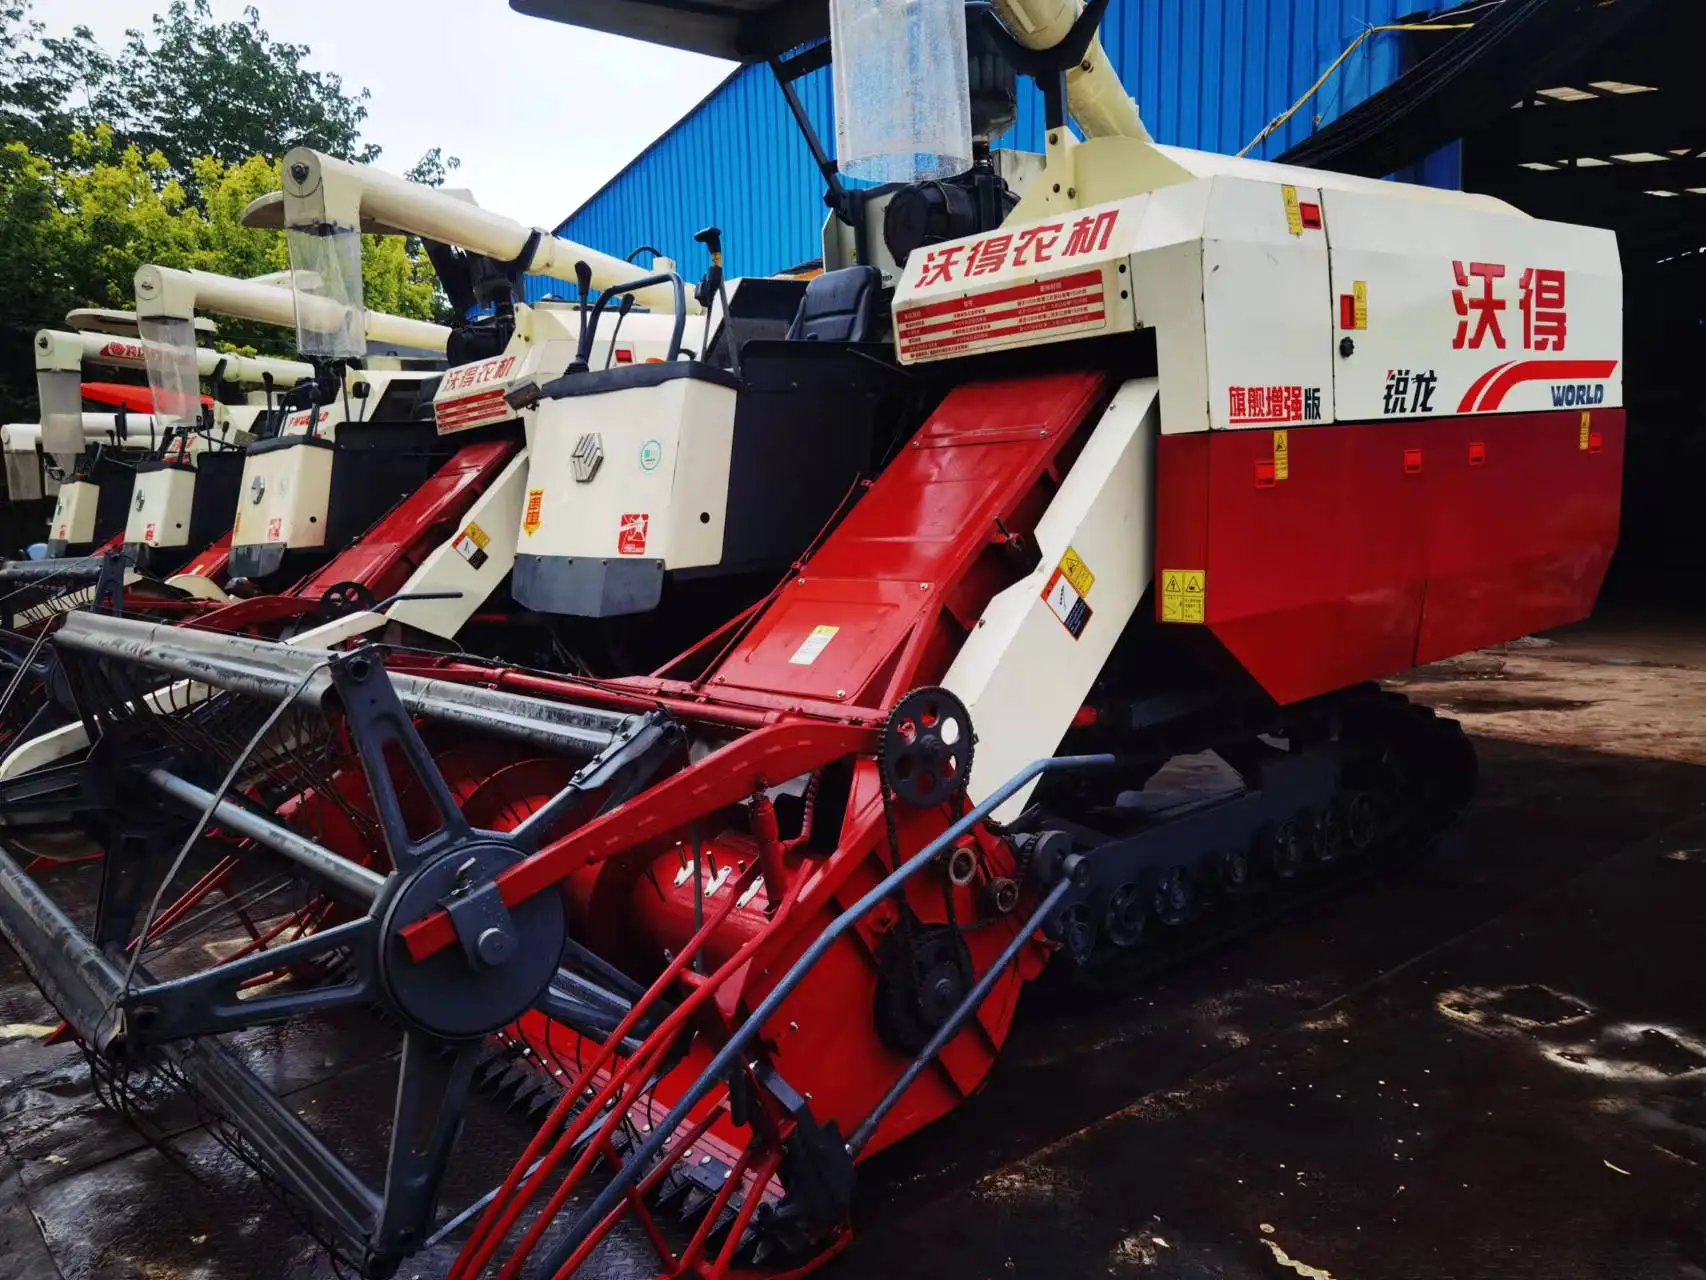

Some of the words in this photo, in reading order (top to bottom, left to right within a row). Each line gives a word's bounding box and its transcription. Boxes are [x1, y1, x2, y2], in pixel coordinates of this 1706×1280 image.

[915, 209, 1119, 288] 沃得农机
[1452, 261, 1567, 351] 沃得
[443, 356, 516, 392] 沃得农机
[1383, 369, 1437, 414] 锐龙
[1229, 386, 1321, 420] 旗舰增强版
[1551, 384, 1604, 407] WORLD
